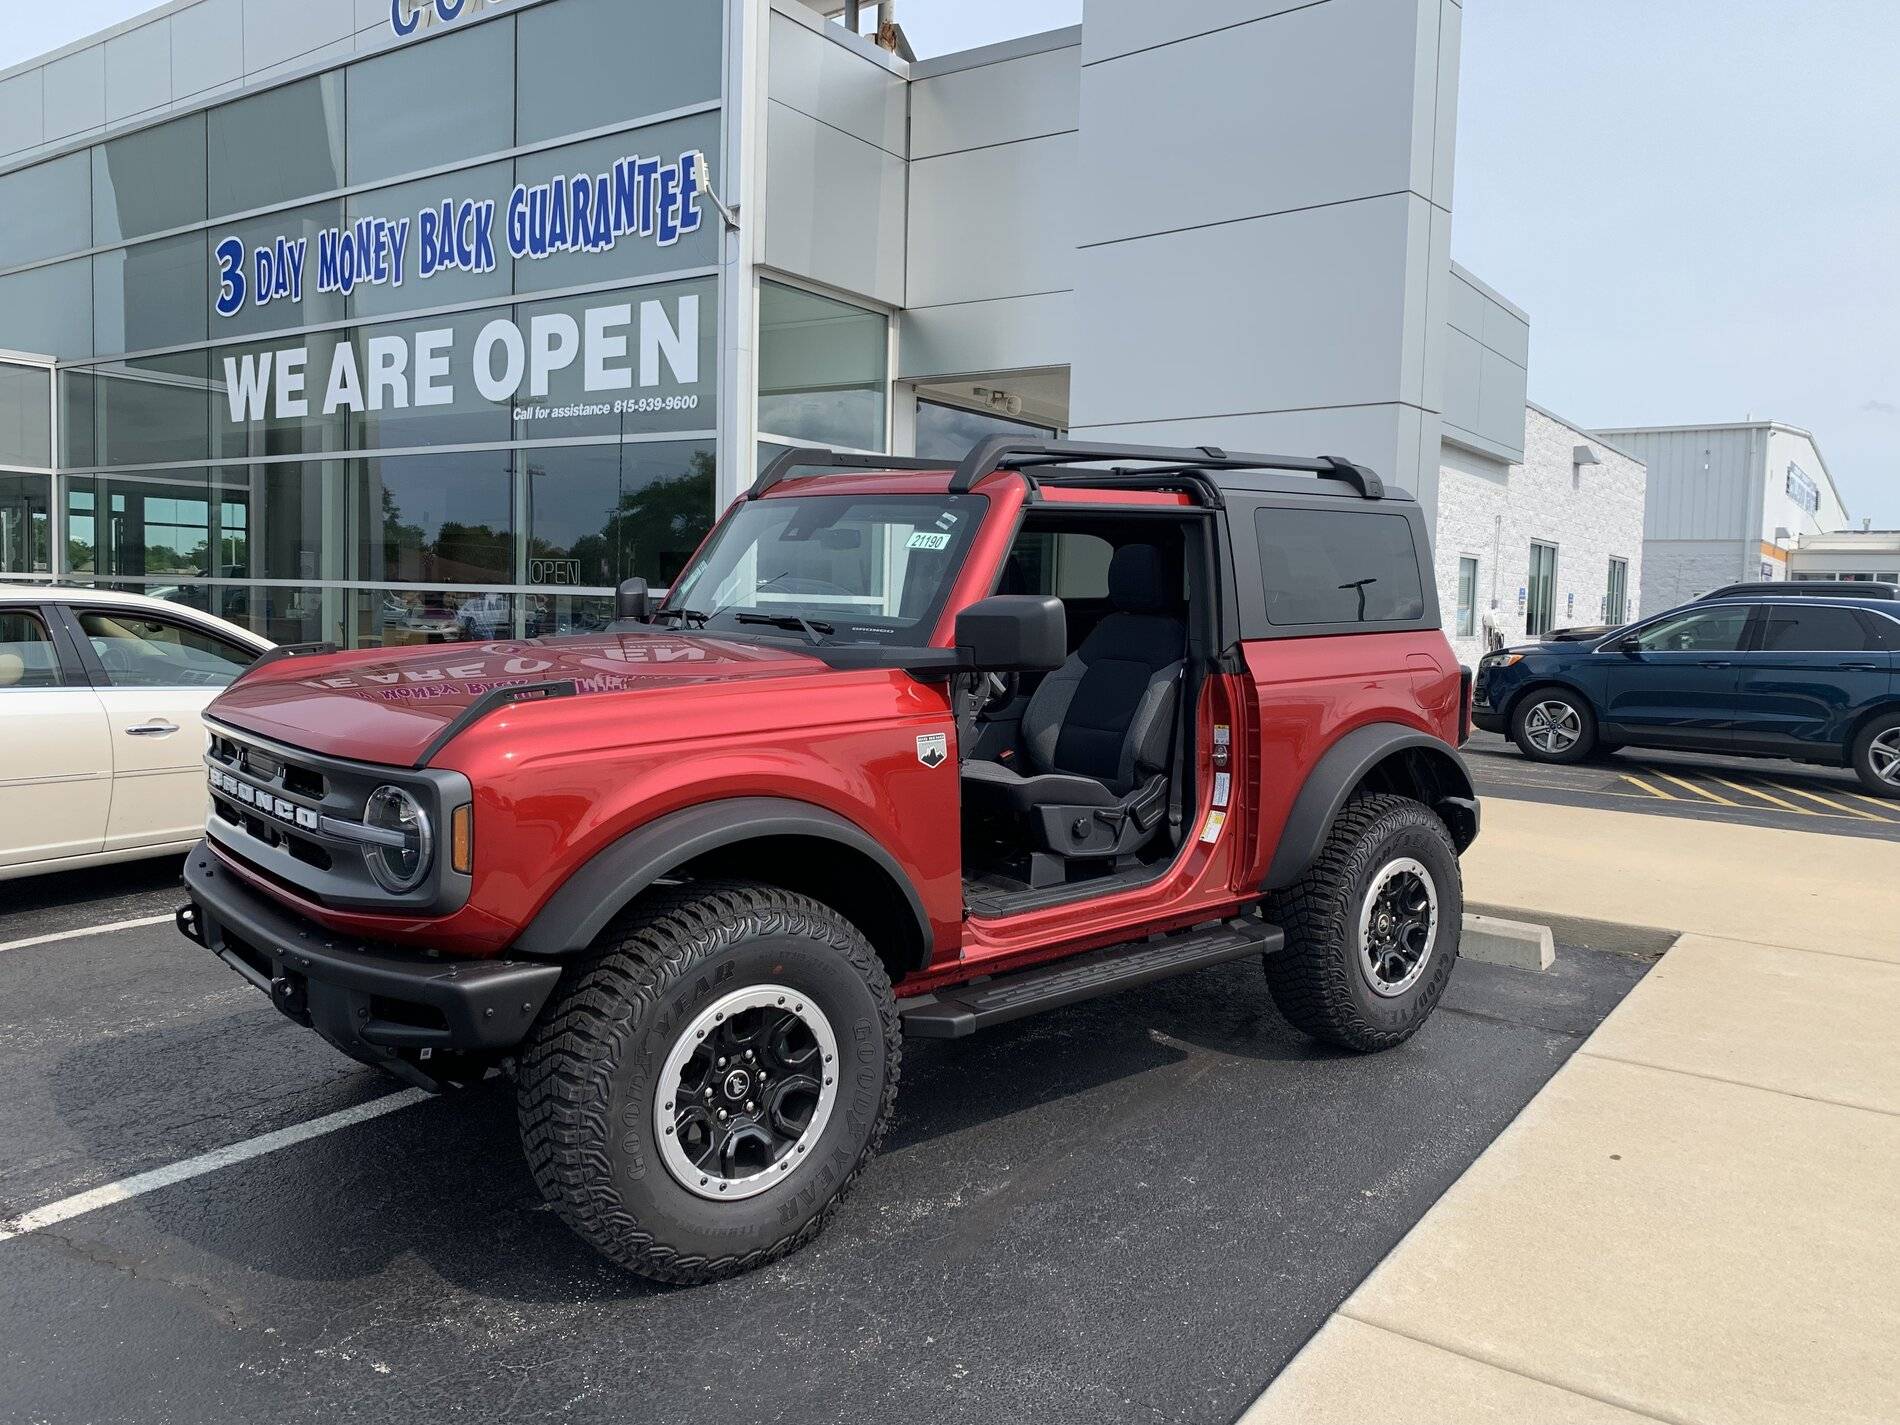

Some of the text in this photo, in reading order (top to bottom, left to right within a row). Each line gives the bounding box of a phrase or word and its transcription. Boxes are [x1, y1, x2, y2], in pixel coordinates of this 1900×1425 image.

[214, 149, 703, 317] 3 DAY MONEY BACK GUARANTEE
[223, 295, 700, 423] WE ARE OPEN
[513, 395, 698, 421] Call for assistance 815-939-9600
[911, 534, 944, 548] 21190
[531, 561, 578, 584] OPEN
[209, 766, 318, 829] BRONCO
